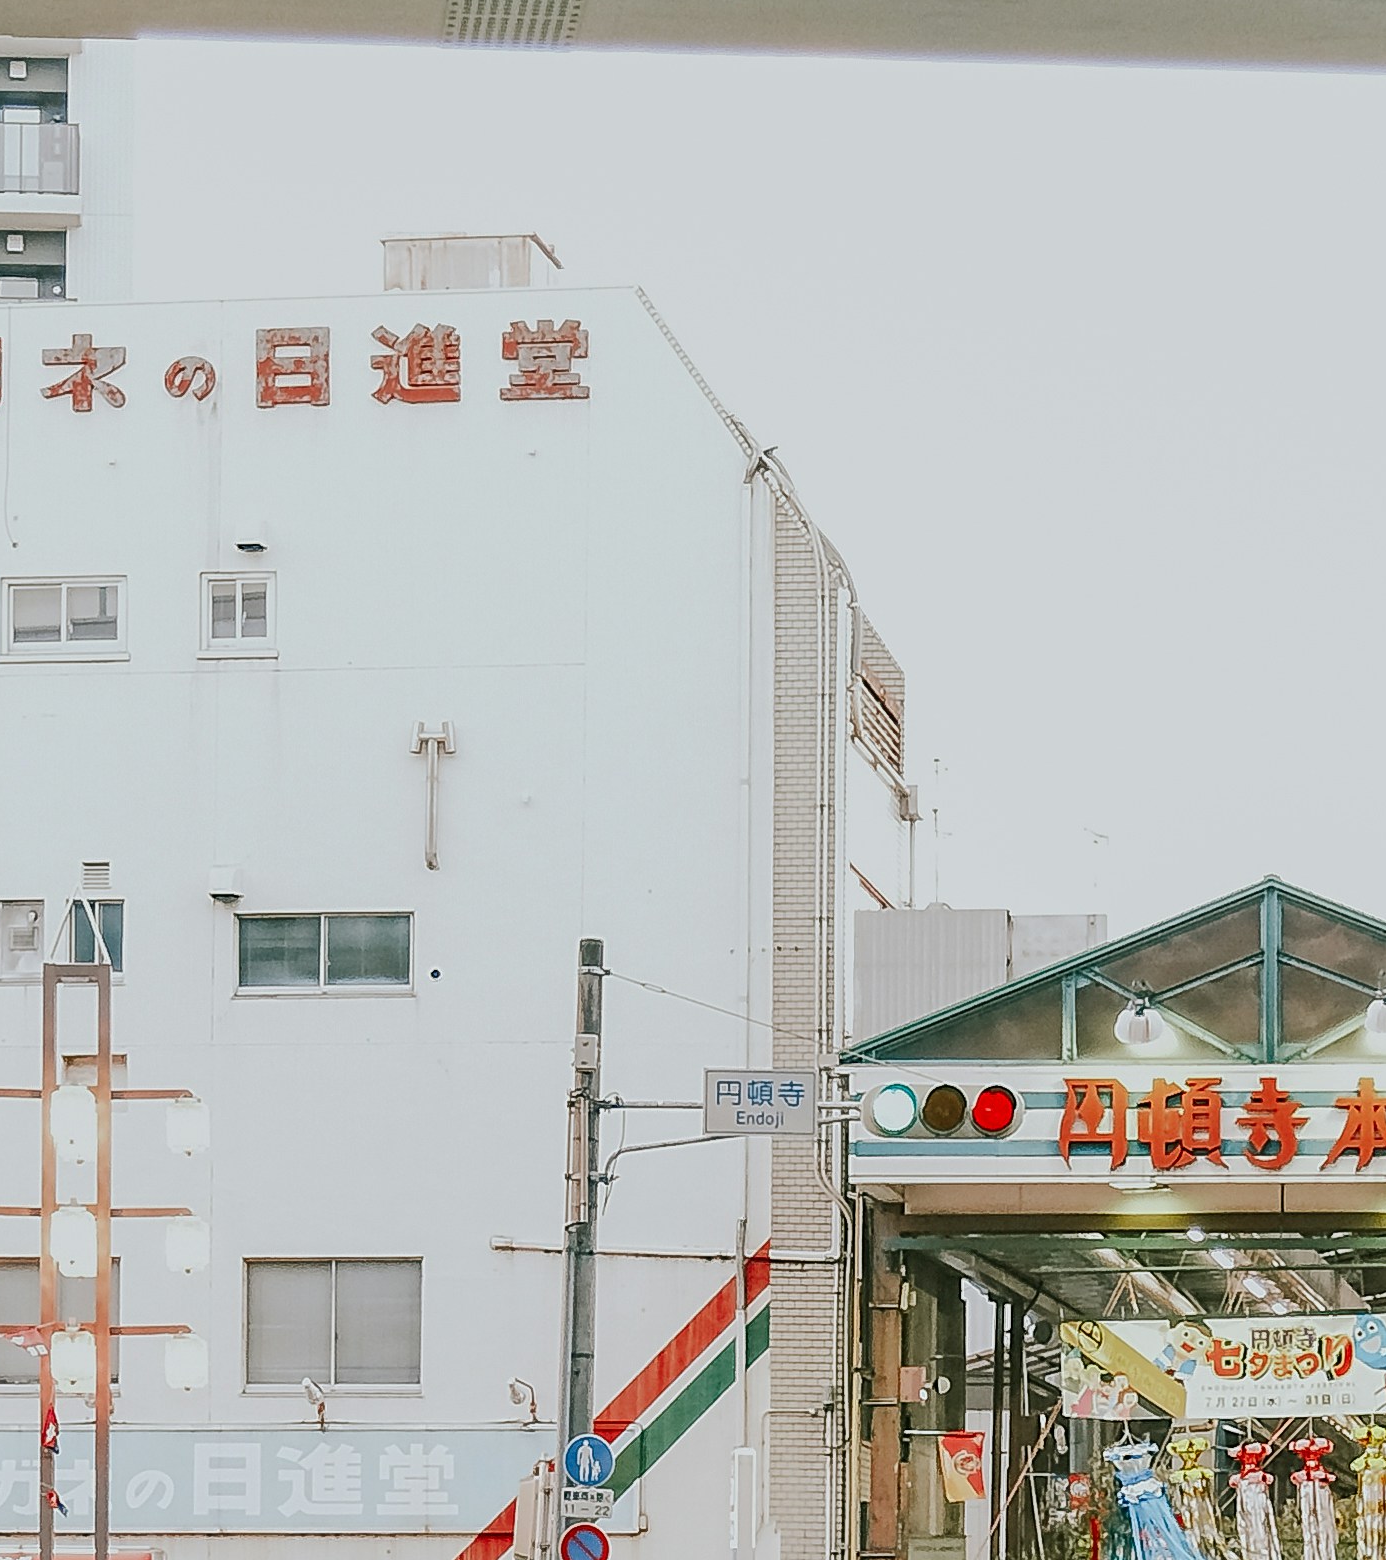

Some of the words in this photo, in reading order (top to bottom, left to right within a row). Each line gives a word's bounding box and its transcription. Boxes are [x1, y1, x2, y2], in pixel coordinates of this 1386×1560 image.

[716, 1080, 805, 1107] 円頓寺
[736, 1111, 784, 1128] Endoji
[1205, 1336, 1354, 1381] 七夕まつり
